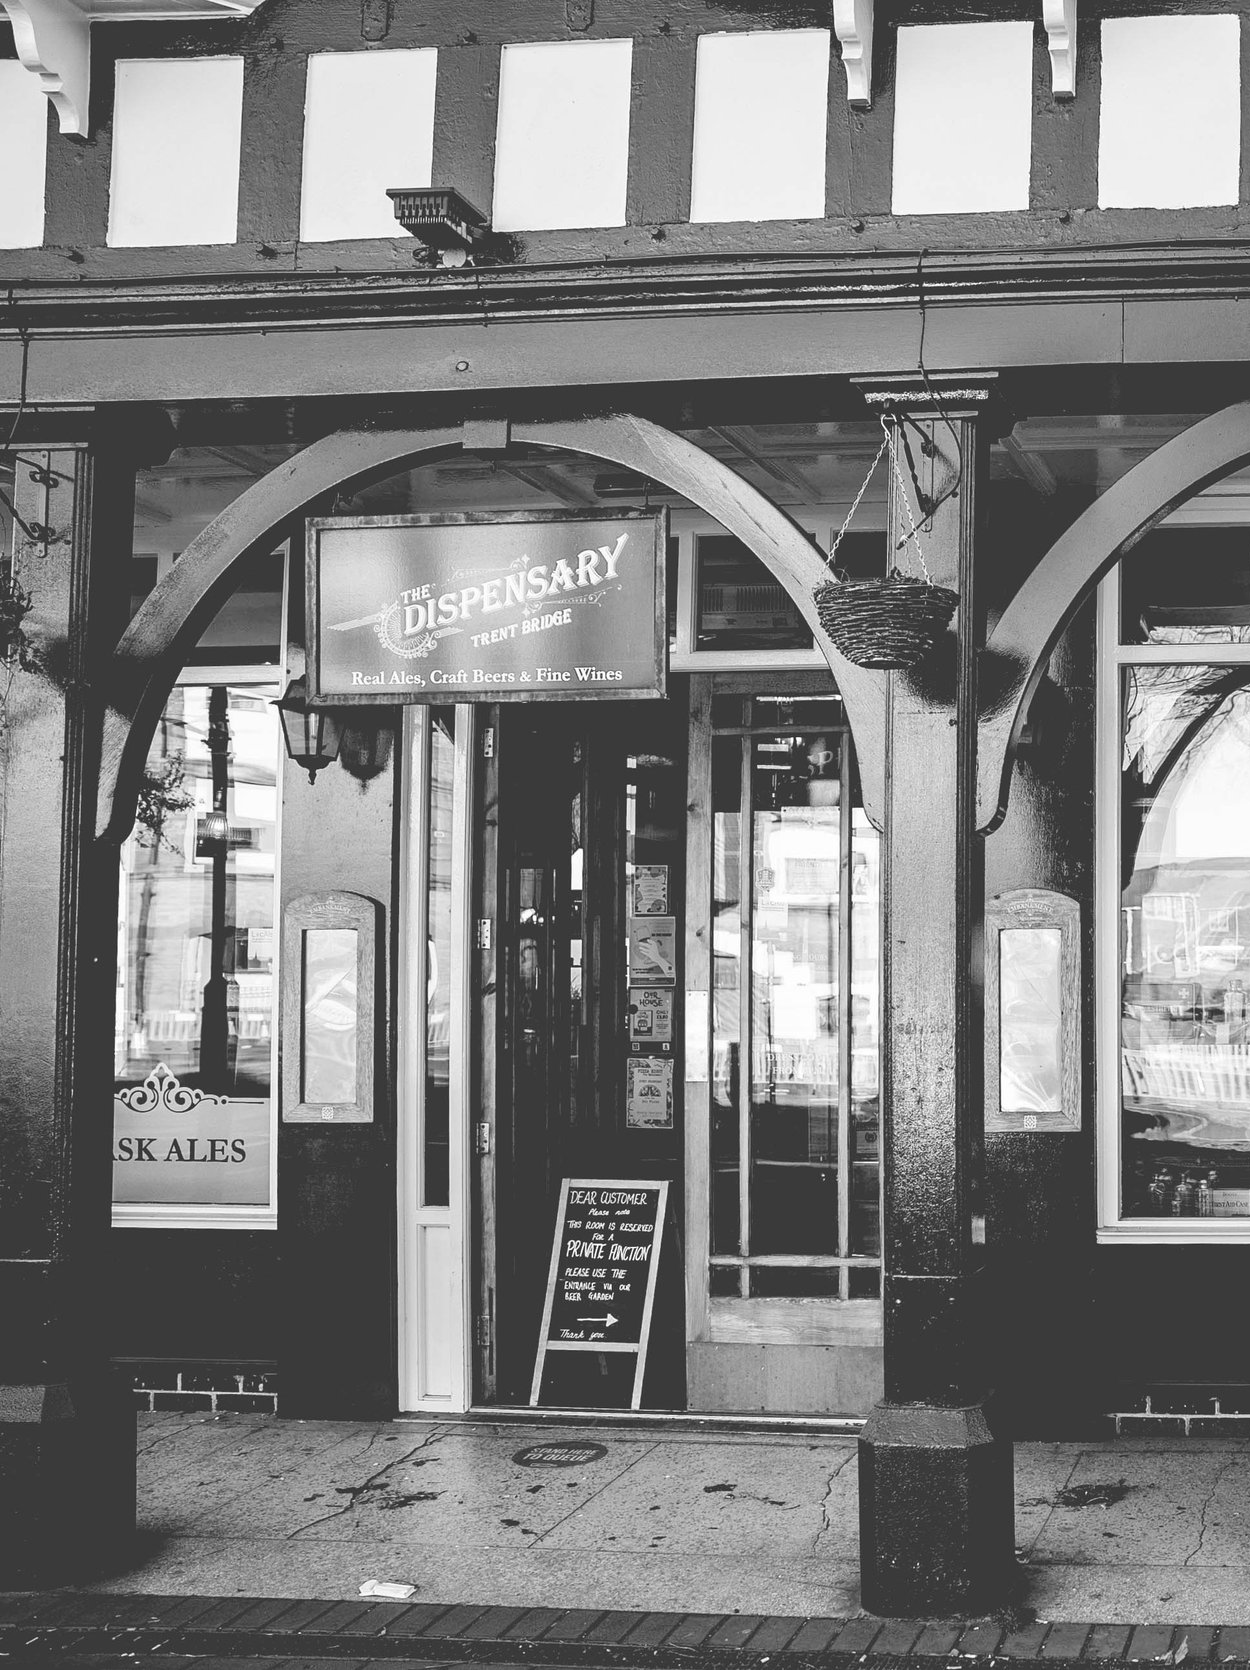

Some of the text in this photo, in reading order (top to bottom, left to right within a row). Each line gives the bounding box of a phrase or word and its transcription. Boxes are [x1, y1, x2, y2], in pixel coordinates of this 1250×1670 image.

[403, 532, 630, 637] DISPENSARY
[401, 584, 431, 604] THE
[471, 608, 573, 648] TRENT BRIDGE
[351, 667, 623, 687] Real Ales, Craft Beers & Fine Wines
[113, 1137, 246, 1162] SK ALES
[569, 1190, 648, 1205] DEAR CUSTOMER
[588, 1207, 631, 1216] Please note
[566, 1219, 654, 1233] THIS ROOM IS RESERVED
[591, 1232, 615, 1241] FOR A
[566, 1239, 652, 1261] PRIVATE FUNCTION
[564, 1267, 628, 1279] PLEASE USE THE
[563, 1280, 632, 1292] ENTRANCE VIA OUR
[564, 1291, 615, 1302] BEER GARDEN
[559, 1328, 585, 1339] Thank
[542, 1454, 592, 1462] QUEUE
